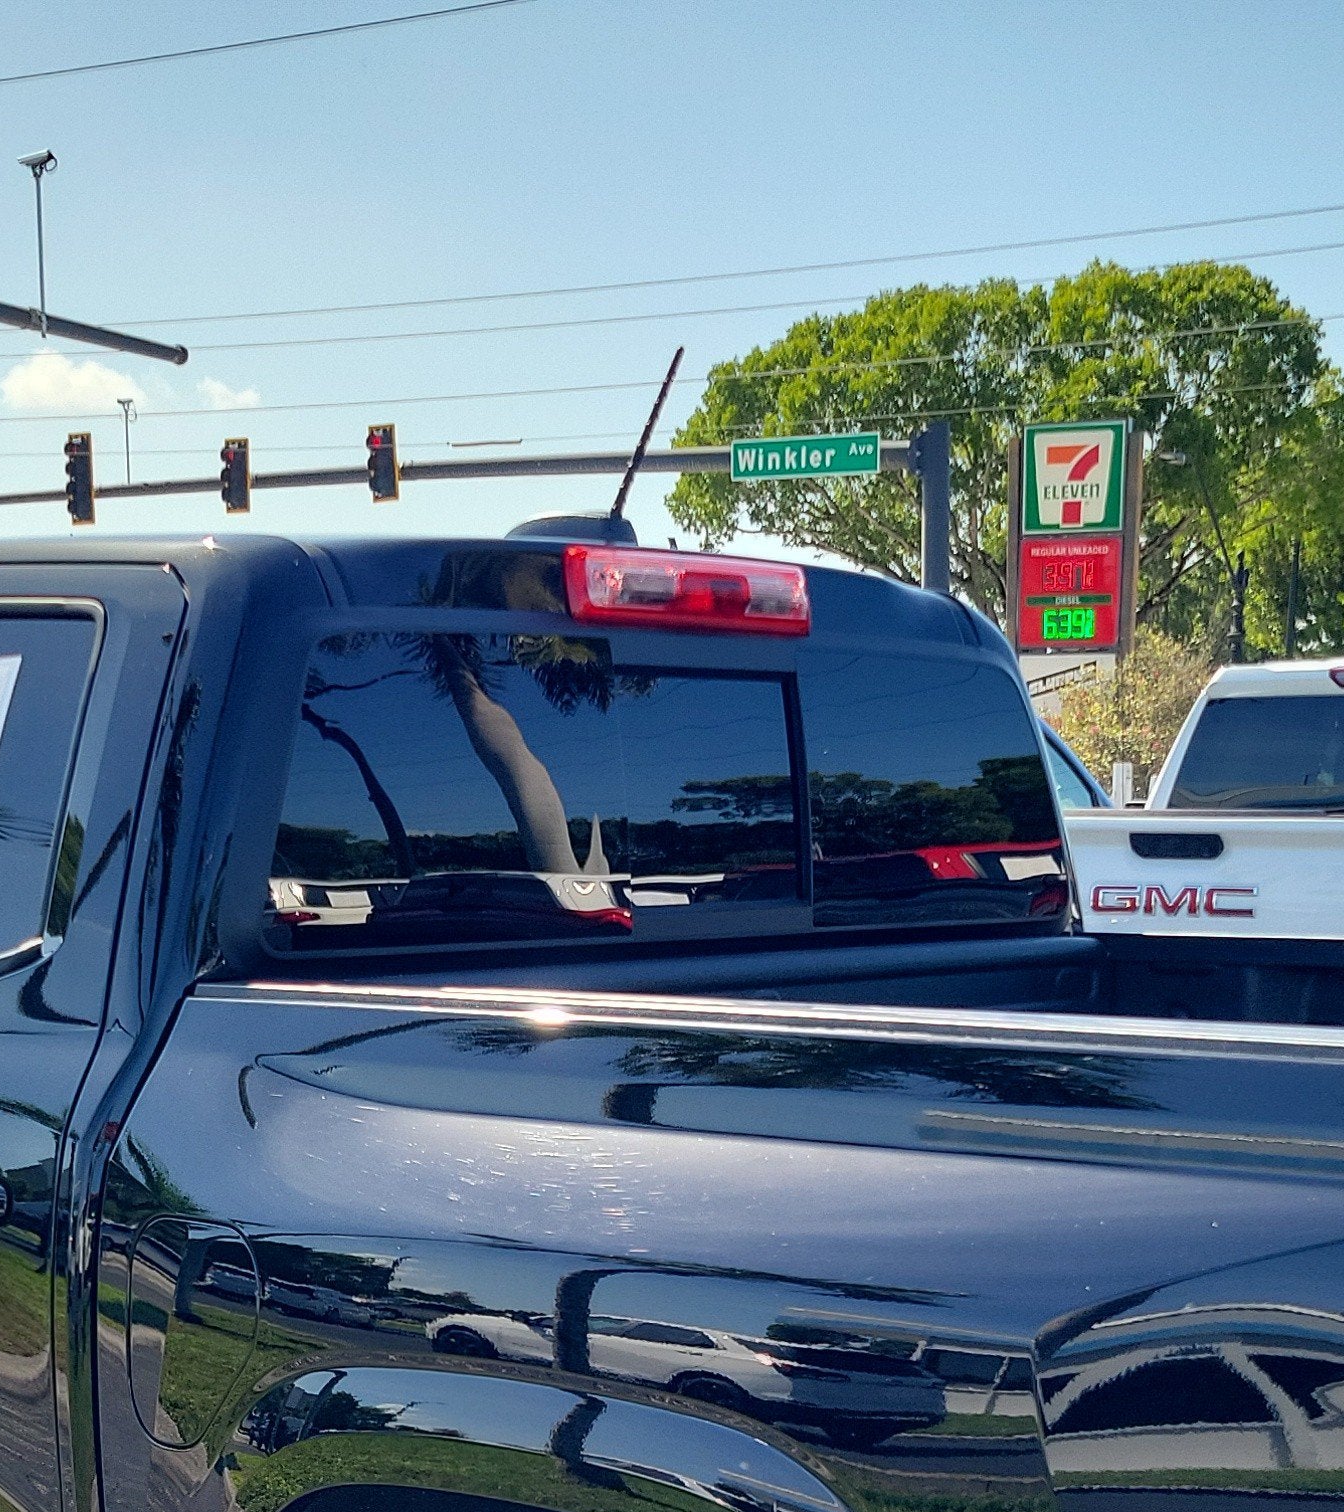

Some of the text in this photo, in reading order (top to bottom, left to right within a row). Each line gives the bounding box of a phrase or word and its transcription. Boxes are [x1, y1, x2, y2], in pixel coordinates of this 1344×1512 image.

[737, 442, 874, 473] Winkler Ave
[1030, 545, 1109, 557] REGULAR UNLEADED
[1055, 596, 1080, 605] DIESEL
[1090, 885, 1258, 918] GMC
